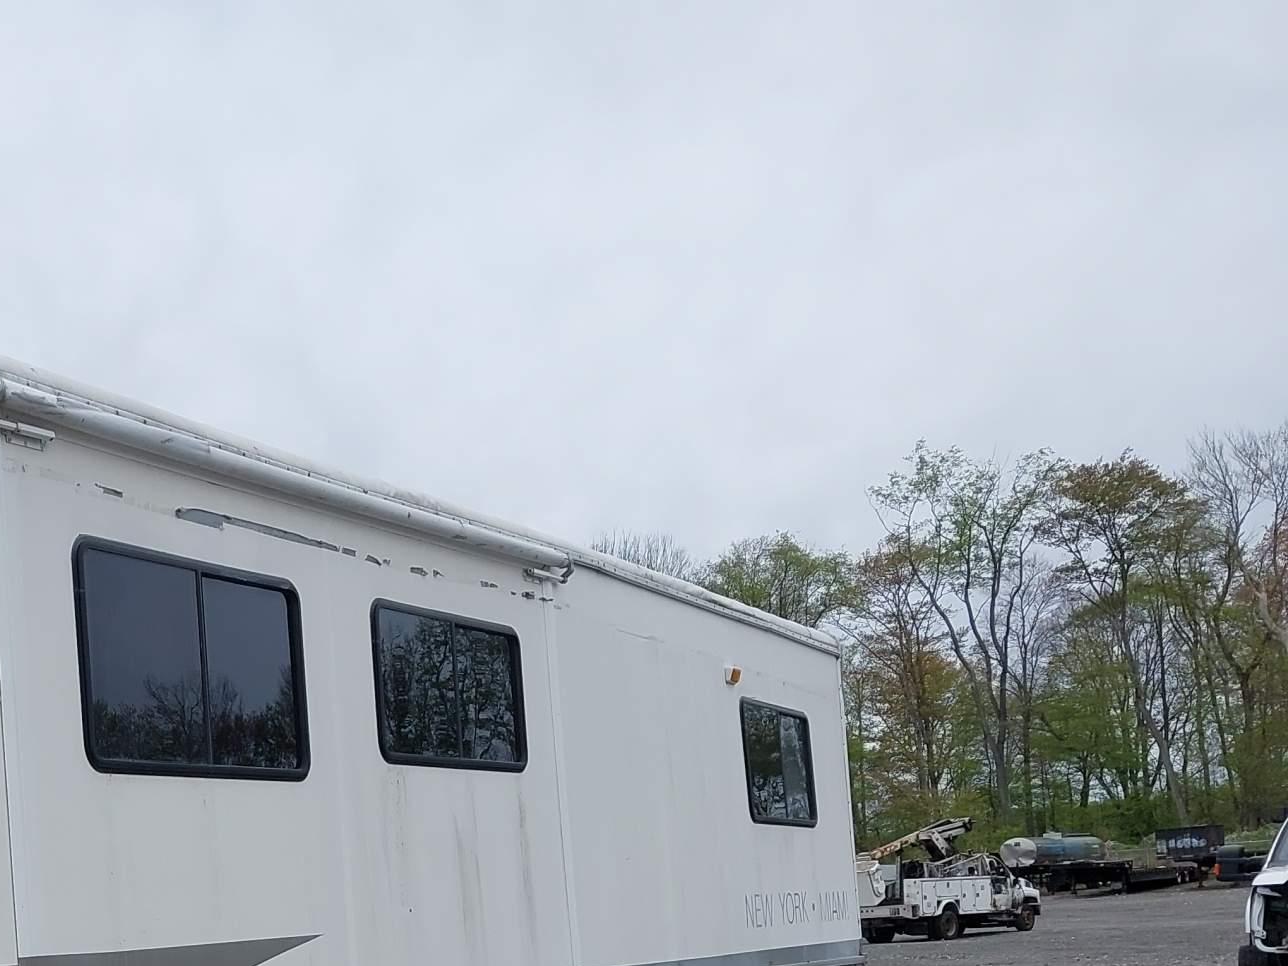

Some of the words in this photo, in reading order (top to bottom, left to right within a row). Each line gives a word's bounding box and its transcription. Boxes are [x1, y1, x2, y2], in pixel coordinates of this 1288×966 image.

[744, 893, 773, 929] NEW
[777, 890, 810, 926] YORK
[818, 890, 850, 921] MIAMI
